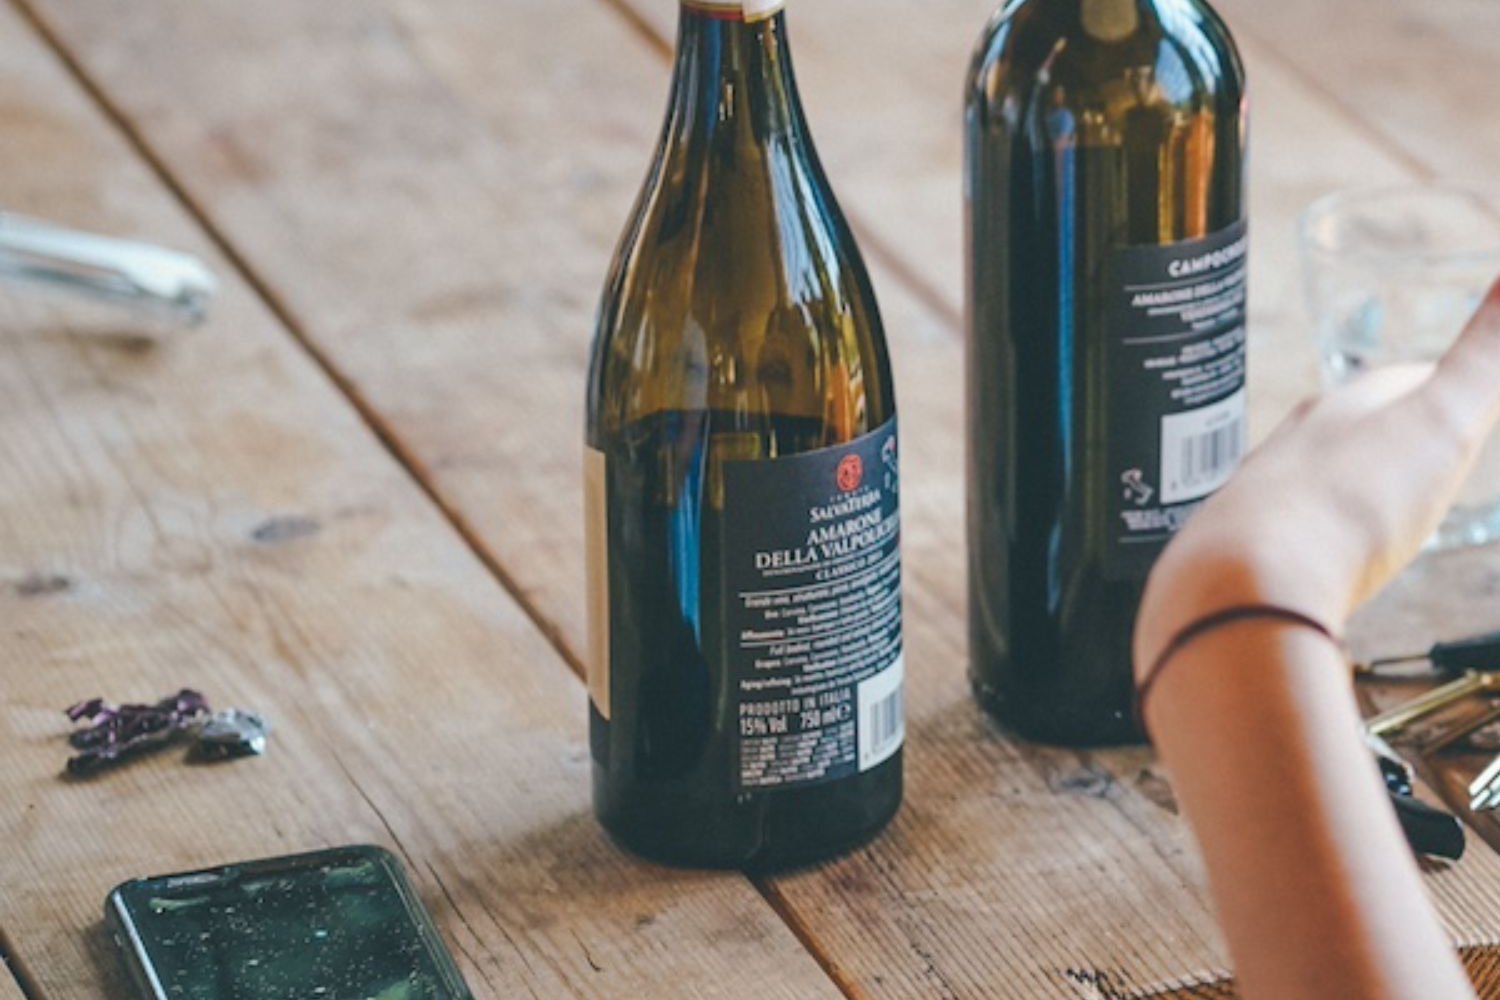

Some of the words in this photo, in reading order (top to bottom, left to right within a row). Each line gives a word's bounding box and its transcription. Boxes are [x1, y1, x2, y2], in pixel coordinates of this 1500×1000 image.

[807, 507, 882, 545] AMARONE
[756, 547, 818, 569] DELLA
[740, 698, 800, 716] PRODOTTO
